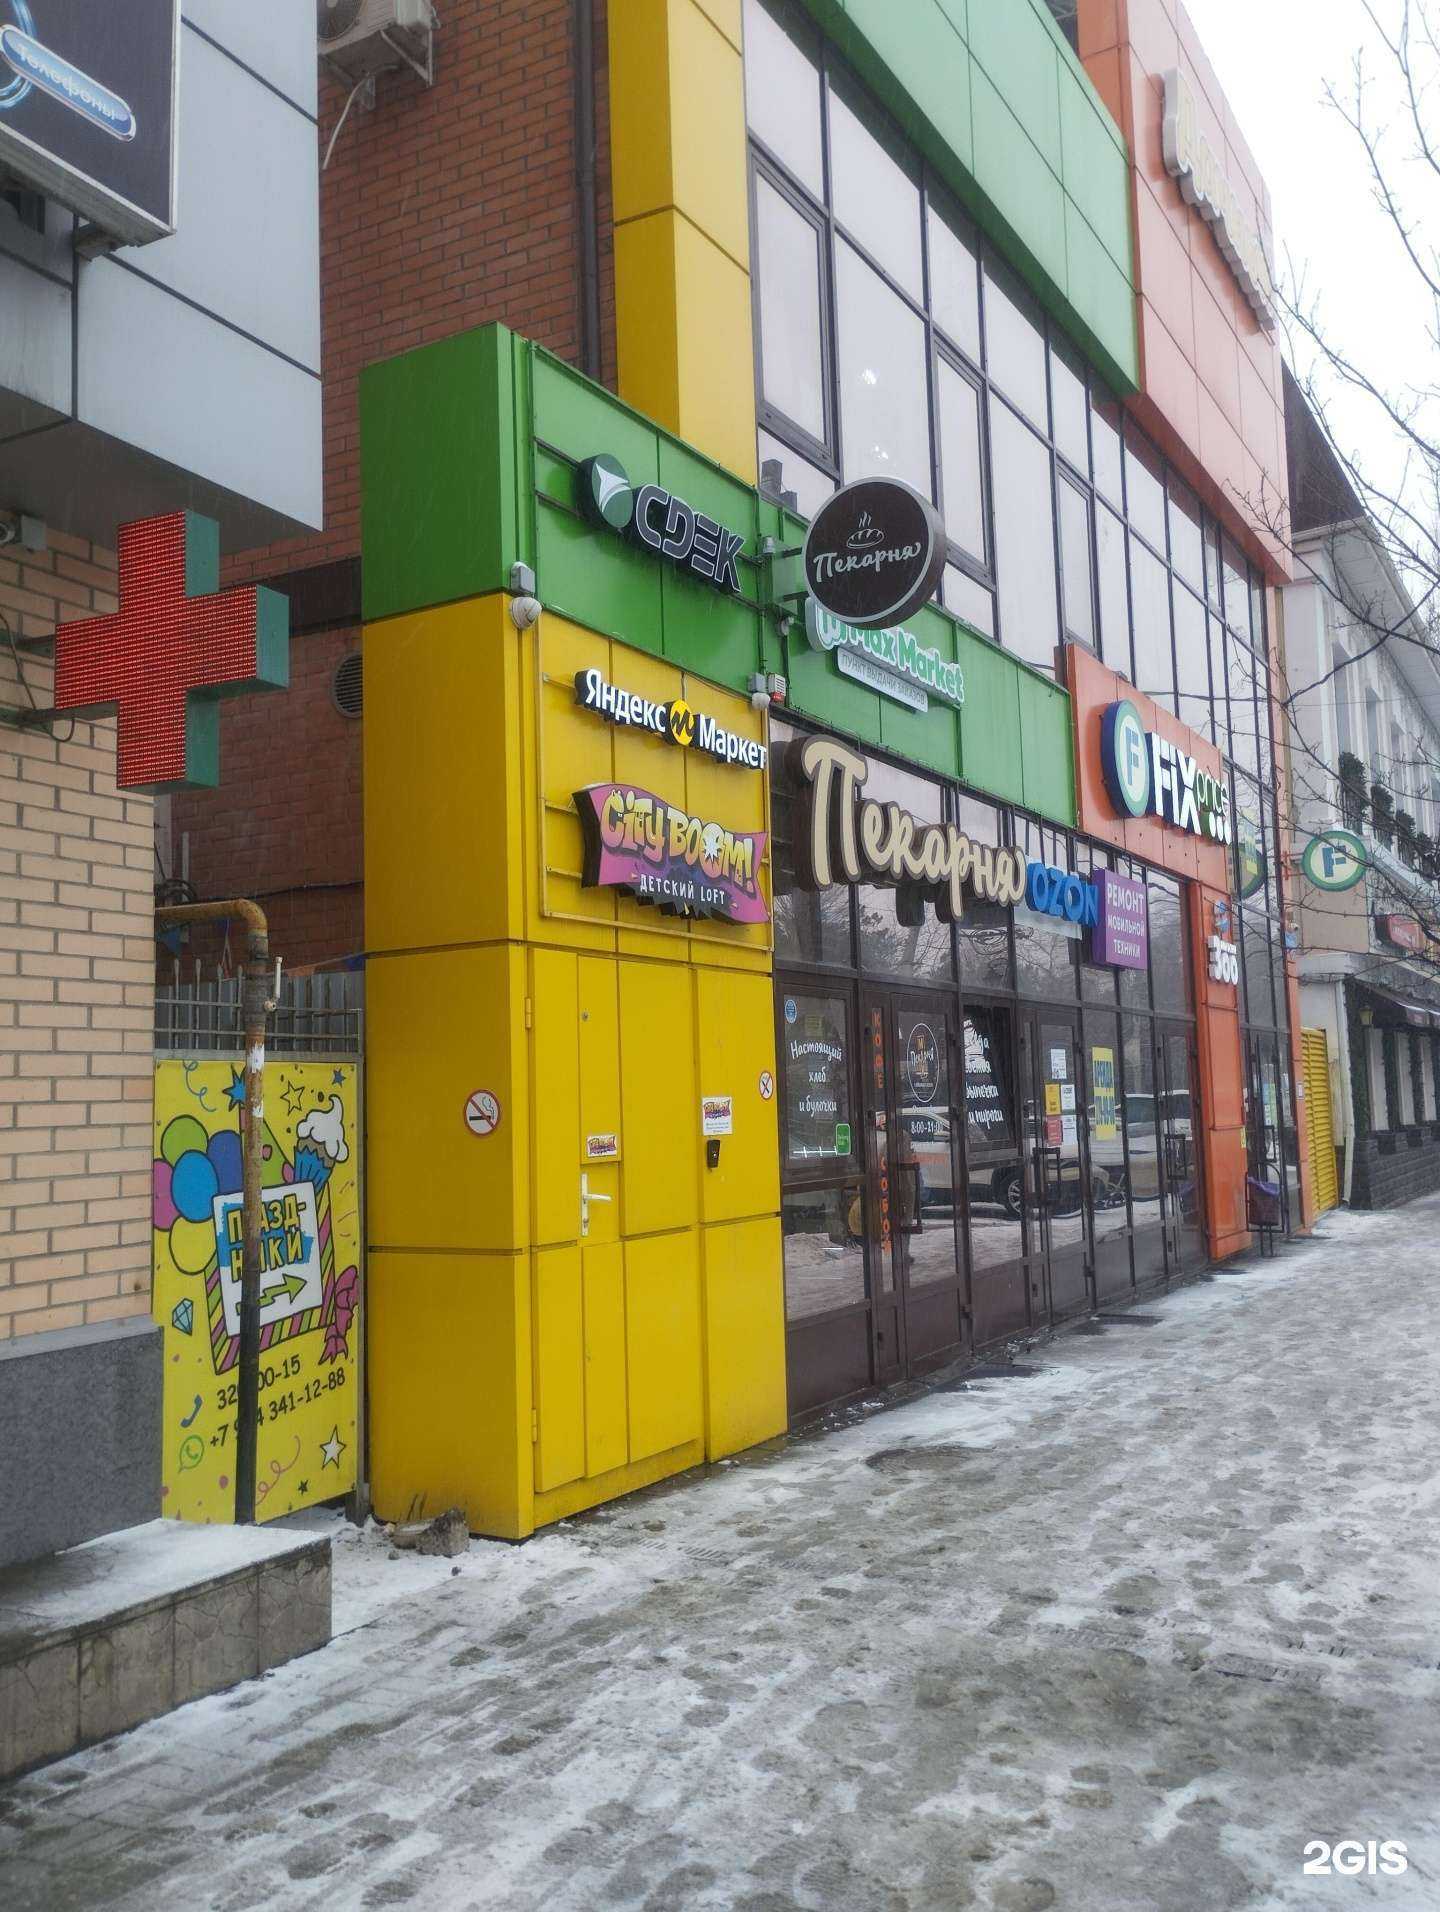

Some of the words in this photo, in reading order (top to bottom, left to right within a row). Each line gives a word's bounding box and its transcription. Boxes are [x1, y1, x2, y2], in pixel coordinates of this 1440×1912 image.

[636, 484, 745, 592] CDEK
[813, 542, 921, 583] Пекарня
[897, 626, 964, 703] Market
[585, 669, 666, 732] Яндекс
[699, 714, 766, 769] Маркет
[801, 737, 1027, 920] Пекарня
[639, 873, 695, 900] ДЕТСКИЙ
[701, 885, 726, 905] LOFT
[1028, 862, 1099, 926] OZON
[1107, 883, 1144, 914] РЕМОНТ
[1107, 914, 1145, 937] МОБИЛЬНОЙ
[1113, 939, 1140, 960] ТЕХНИКИ
[790, 1040, 842, 1061] Настоящий
[808, 1066, 827, 1083] хлеб
[806, 1095, 837, 1117] булочки
[976, 1110, 1003, 1129] пироги
[210, 1424, 228, 1447] +7
[268, 1366, 346, 1421] 341-12-88
